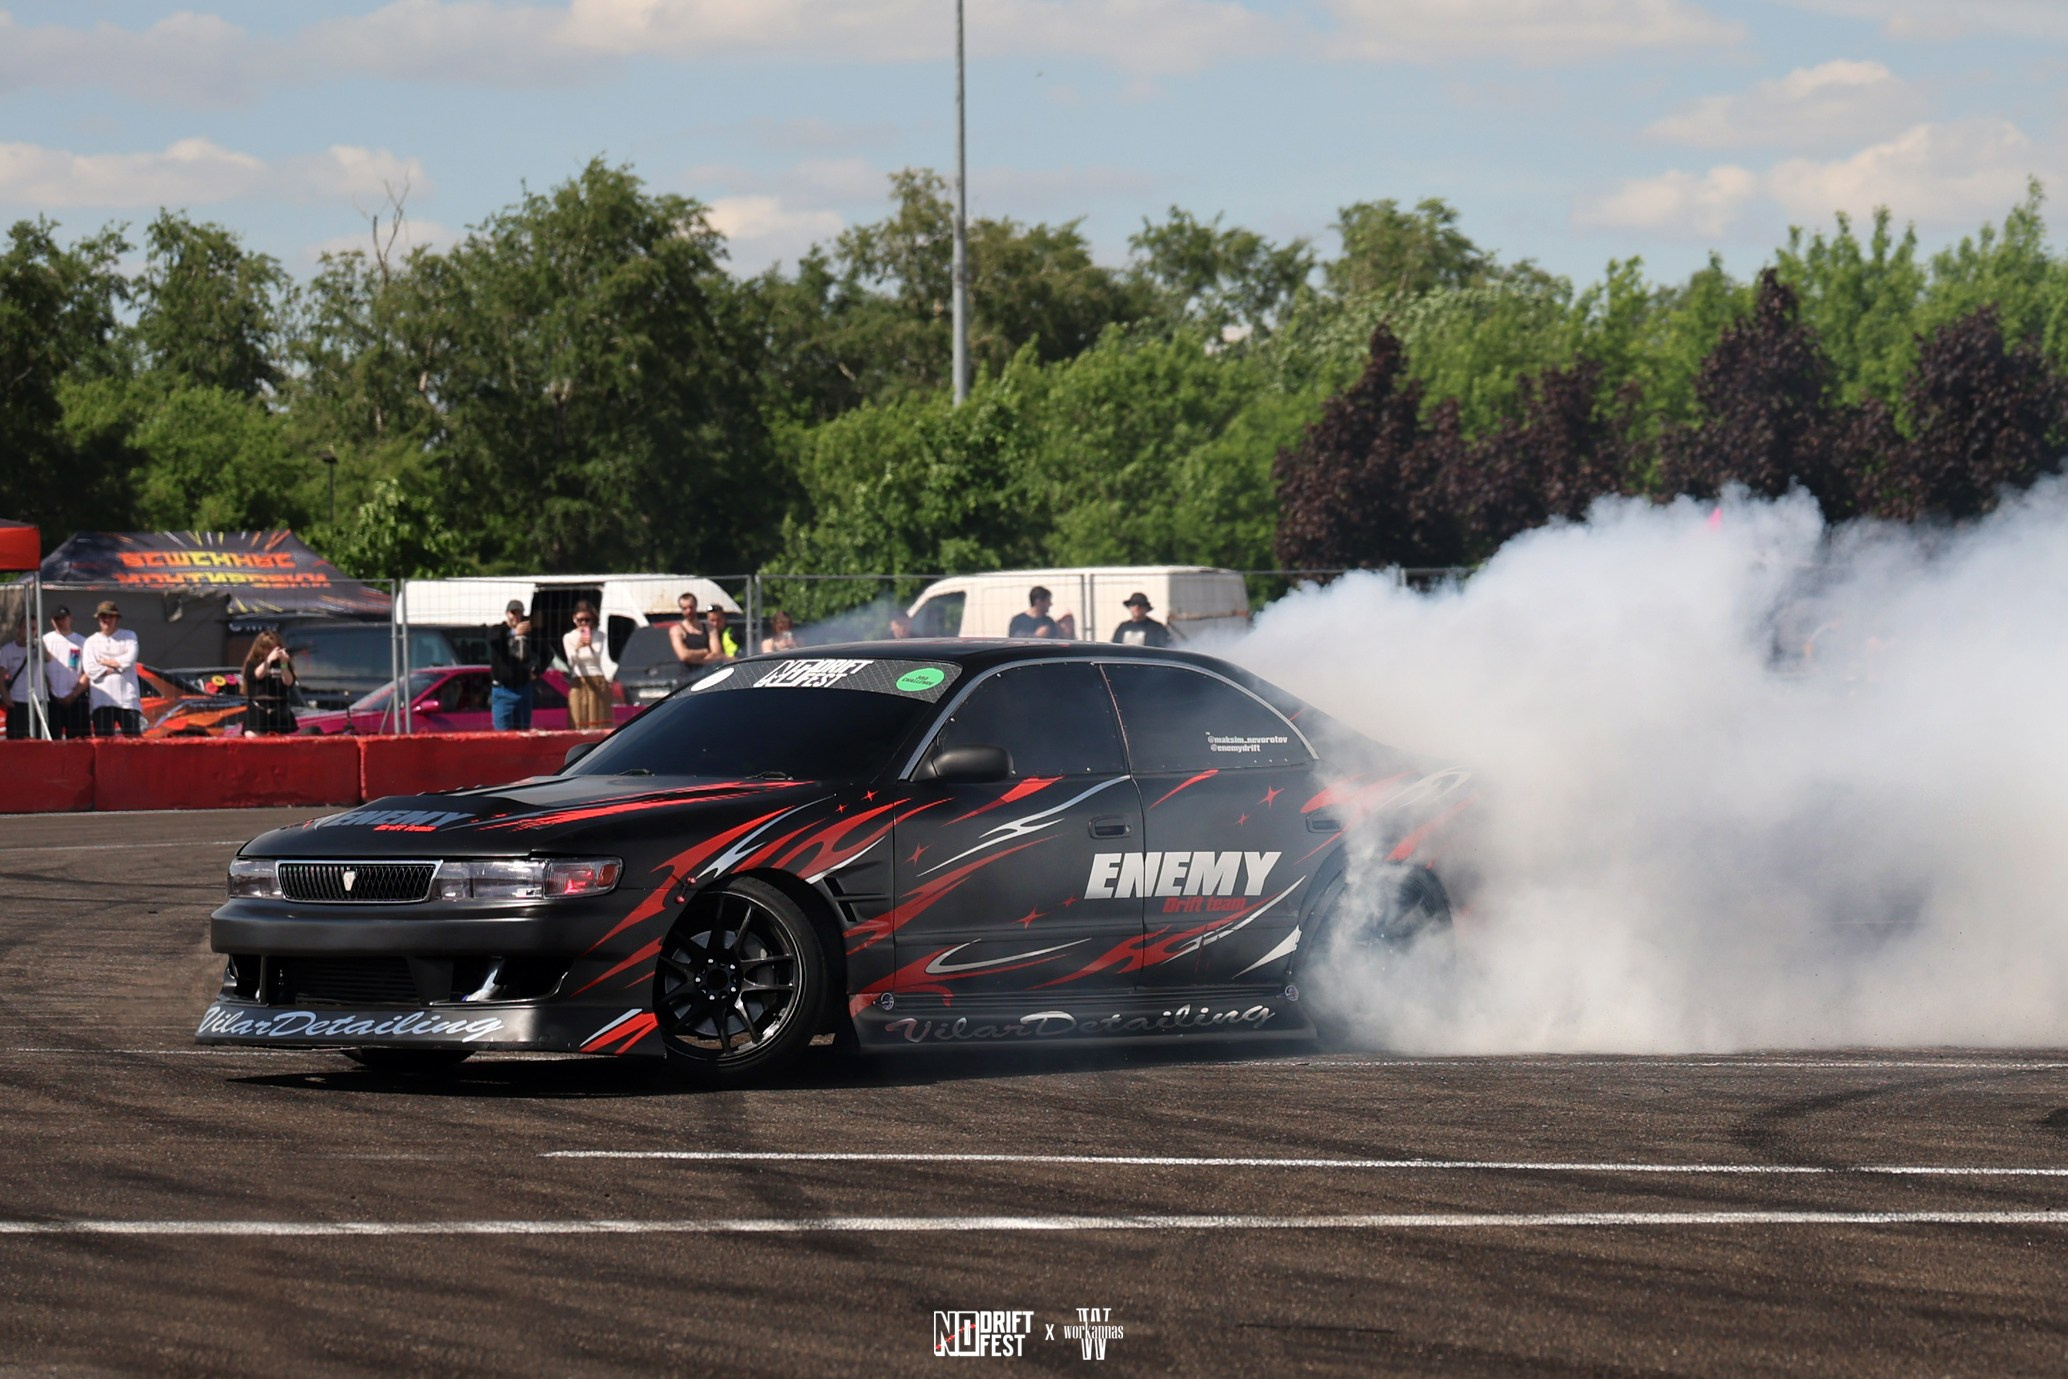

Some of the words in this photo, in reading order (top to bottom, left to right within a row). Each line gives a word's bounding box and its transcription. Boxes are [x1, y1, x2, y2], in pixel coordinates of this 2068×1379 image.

[806, 659, 874, 674] DRIFT
[800, 673, 848, 688] FEST
[1210, 744, 1261, 753] @enemydrift
[321, 810, 477, 827] ENEMY
[1084, 851, 1282, 900] ENEMY
[1163, 896, 1203, 913] Drift
[1207, 896, 1246, 911] team
